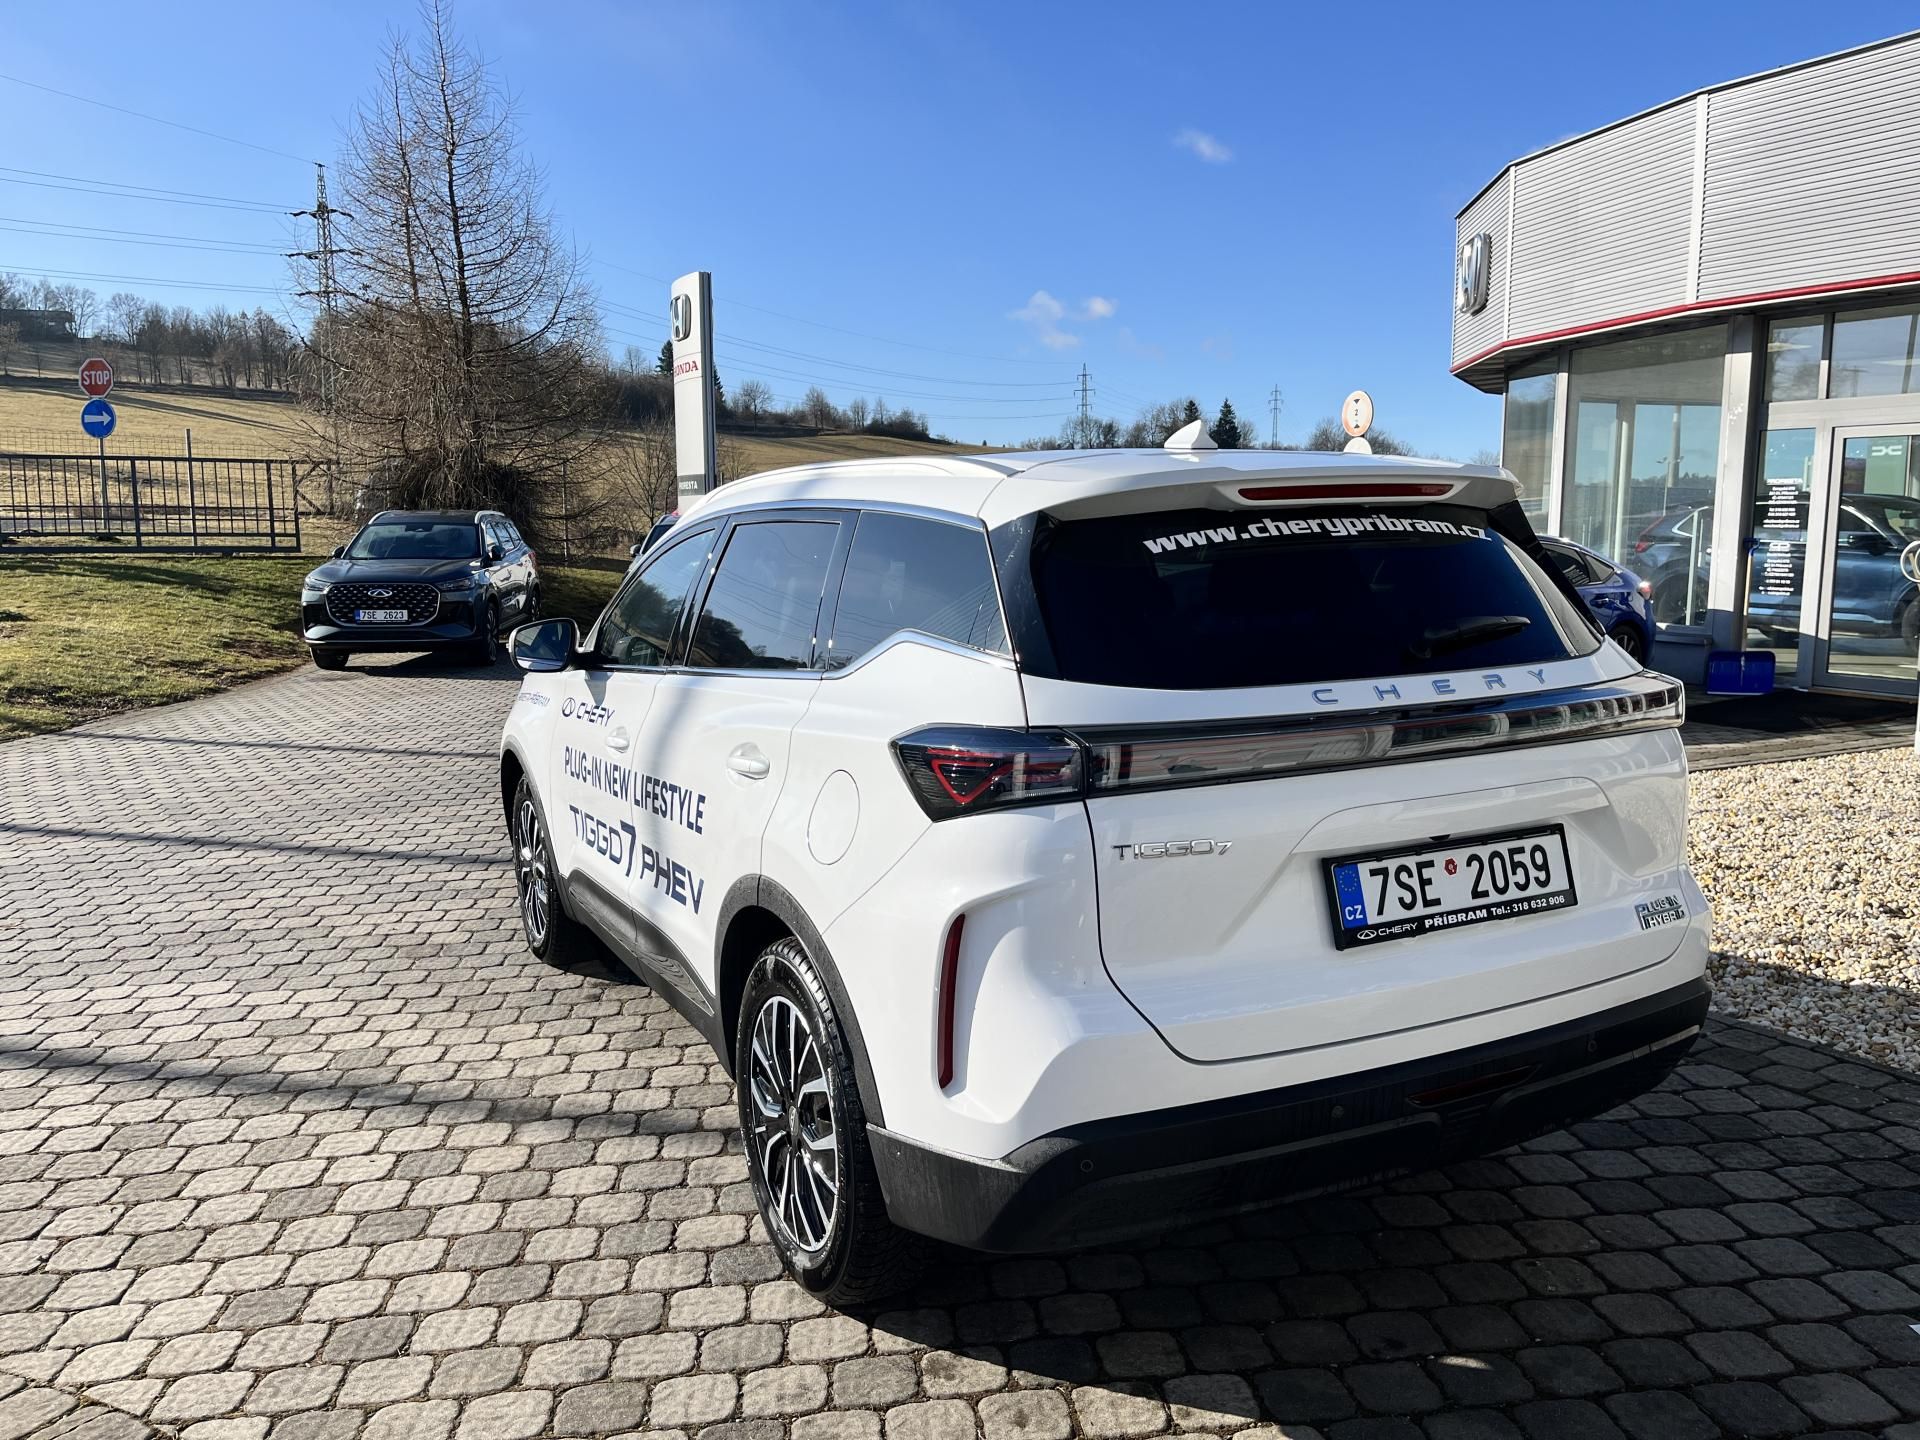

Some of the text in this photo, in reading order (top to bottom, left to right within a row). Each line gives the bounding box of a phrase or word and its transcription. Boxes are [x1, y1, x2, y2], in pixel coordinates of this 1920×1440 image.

[83, 370, 110, 385] STOP
[674, 360, 699, 377] ONDA
[1143, 514, 1492, 554] www.cherypribram.cz
[361, 610, 404, 620] 7SE 2623
[1312, 668, 1546, 705] CHERY
[576, 702, 615, 726] CHERY
[564, 746, 706, 835] PLUG-IN NEW LIFESTYLE
[640, 844, 704, 915] PHEV
[1345, 844, 1551, 921] CZ 7SE 2059
[1378, 895, 1565, 936] CHERY PŘÍBRAM Tel.: 318 632 906
